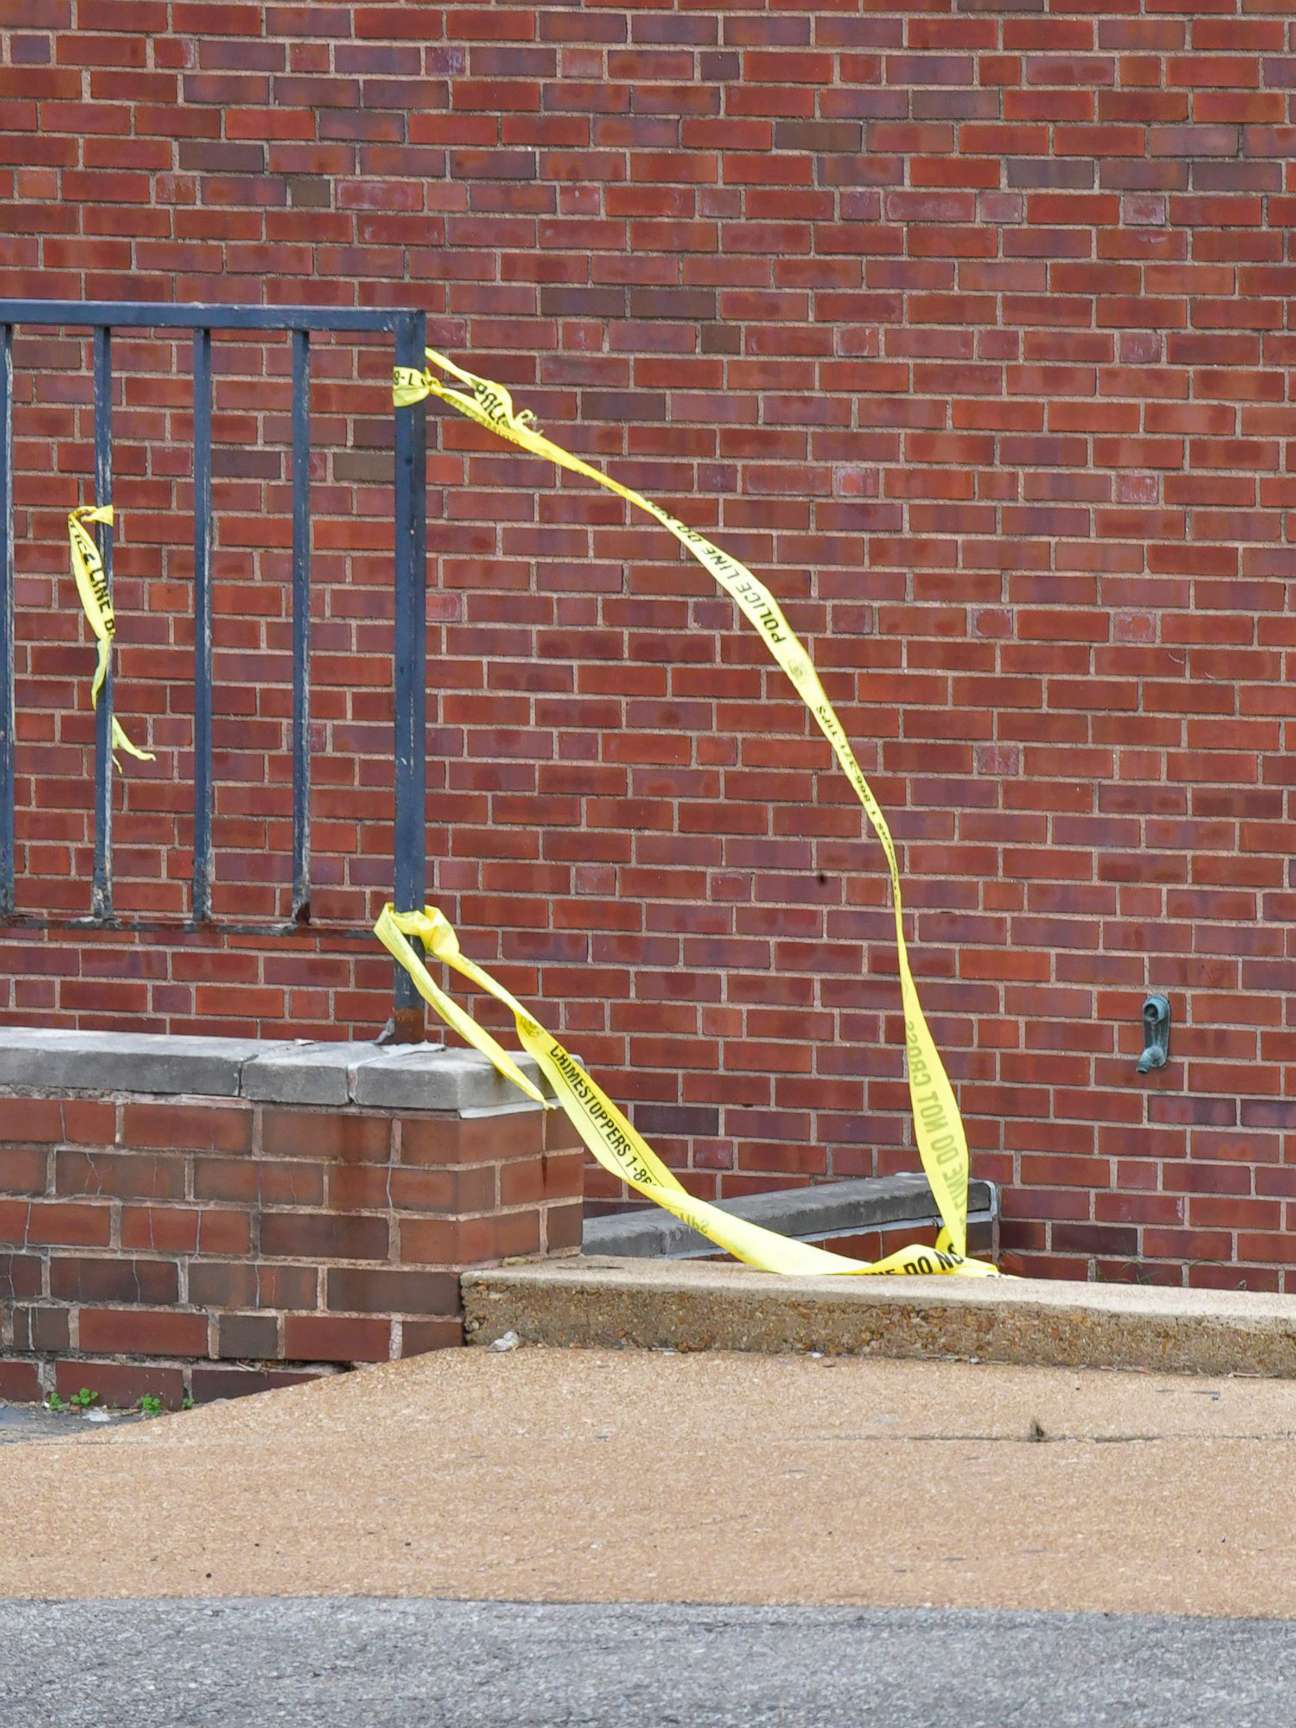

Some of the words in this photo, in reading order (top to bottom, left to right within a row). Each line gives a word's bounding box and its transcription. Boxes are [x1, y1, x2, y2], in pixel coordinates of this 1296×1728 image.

[677, 514, 703, 543] DO
[702, 547, 740, 580] LINE
[89, 568, 111, 614] LINE
[735, 582, 787, 644] POLICE
[550, 1045, 631, 1157] CRIMESTOPPERS
